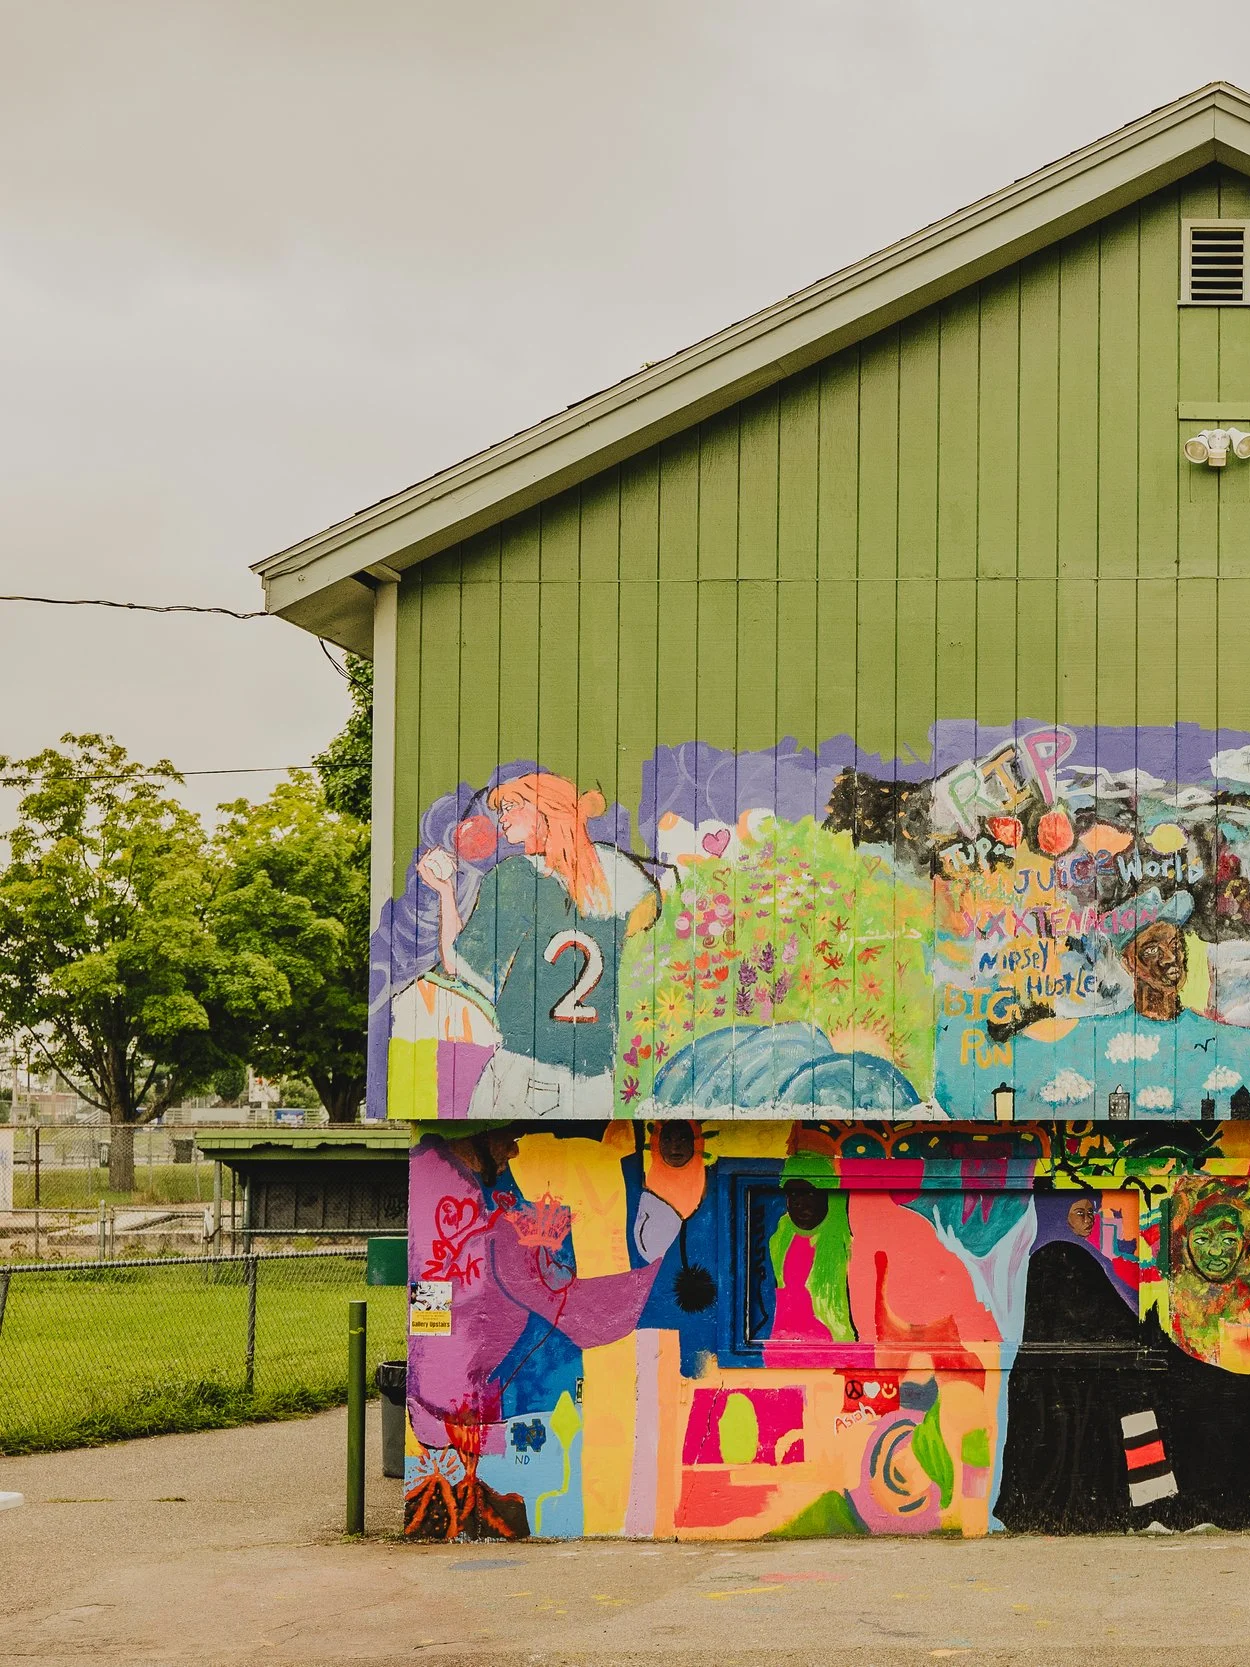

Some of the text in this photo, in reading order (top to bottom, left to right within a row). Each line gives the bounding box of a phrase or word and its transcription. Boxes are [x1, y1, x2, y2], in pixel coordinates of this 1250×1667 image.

[948, 730, 1074, 828] RIP
[544, 929, 605, 1023] 2
[943, 982, 1022, 1026] BIG
[514, 1455, 530, 1465] ND
